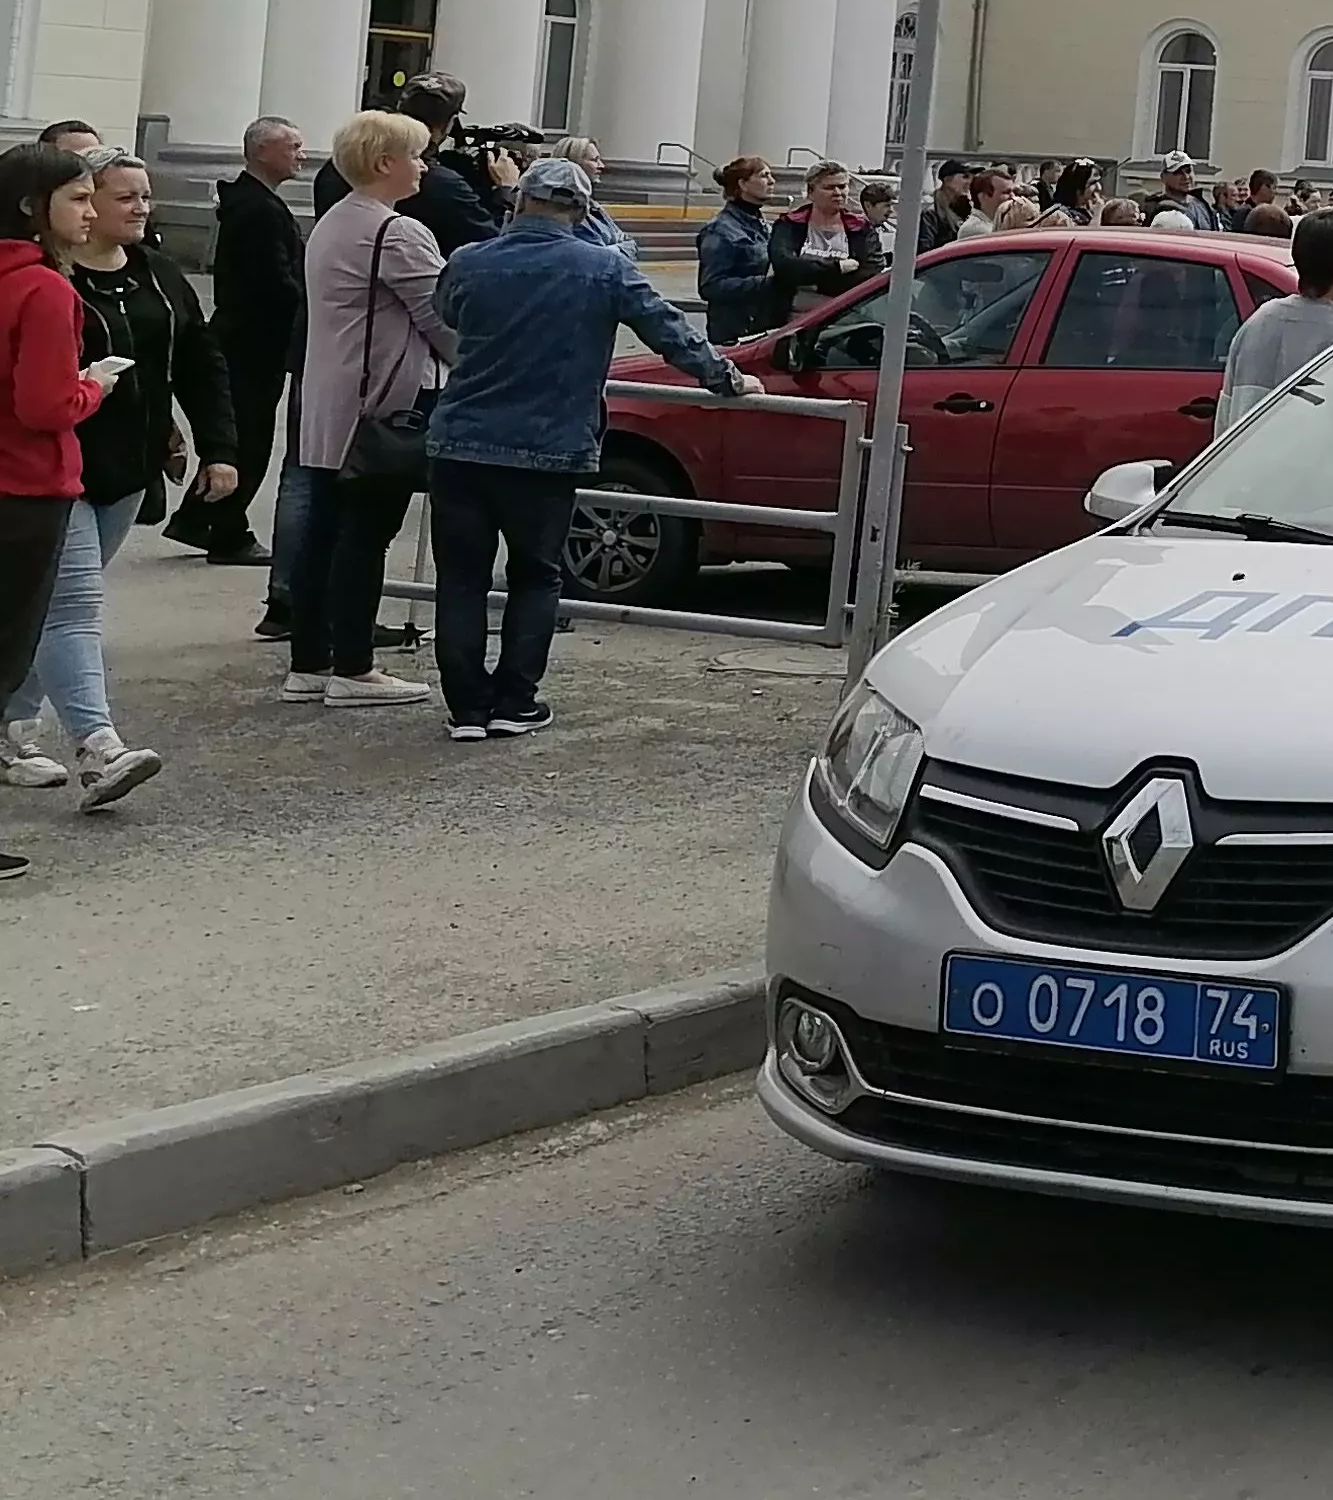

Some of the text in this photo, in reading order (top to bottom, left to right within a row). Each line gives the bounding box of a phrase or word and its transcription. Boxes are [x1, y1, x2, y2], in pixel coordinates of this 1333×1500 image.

[1028, 974, 1166, 1046] 0718
[1206, 989, 1258, 1040] 74
[1209, 1039, 1249, 1059] RUS
